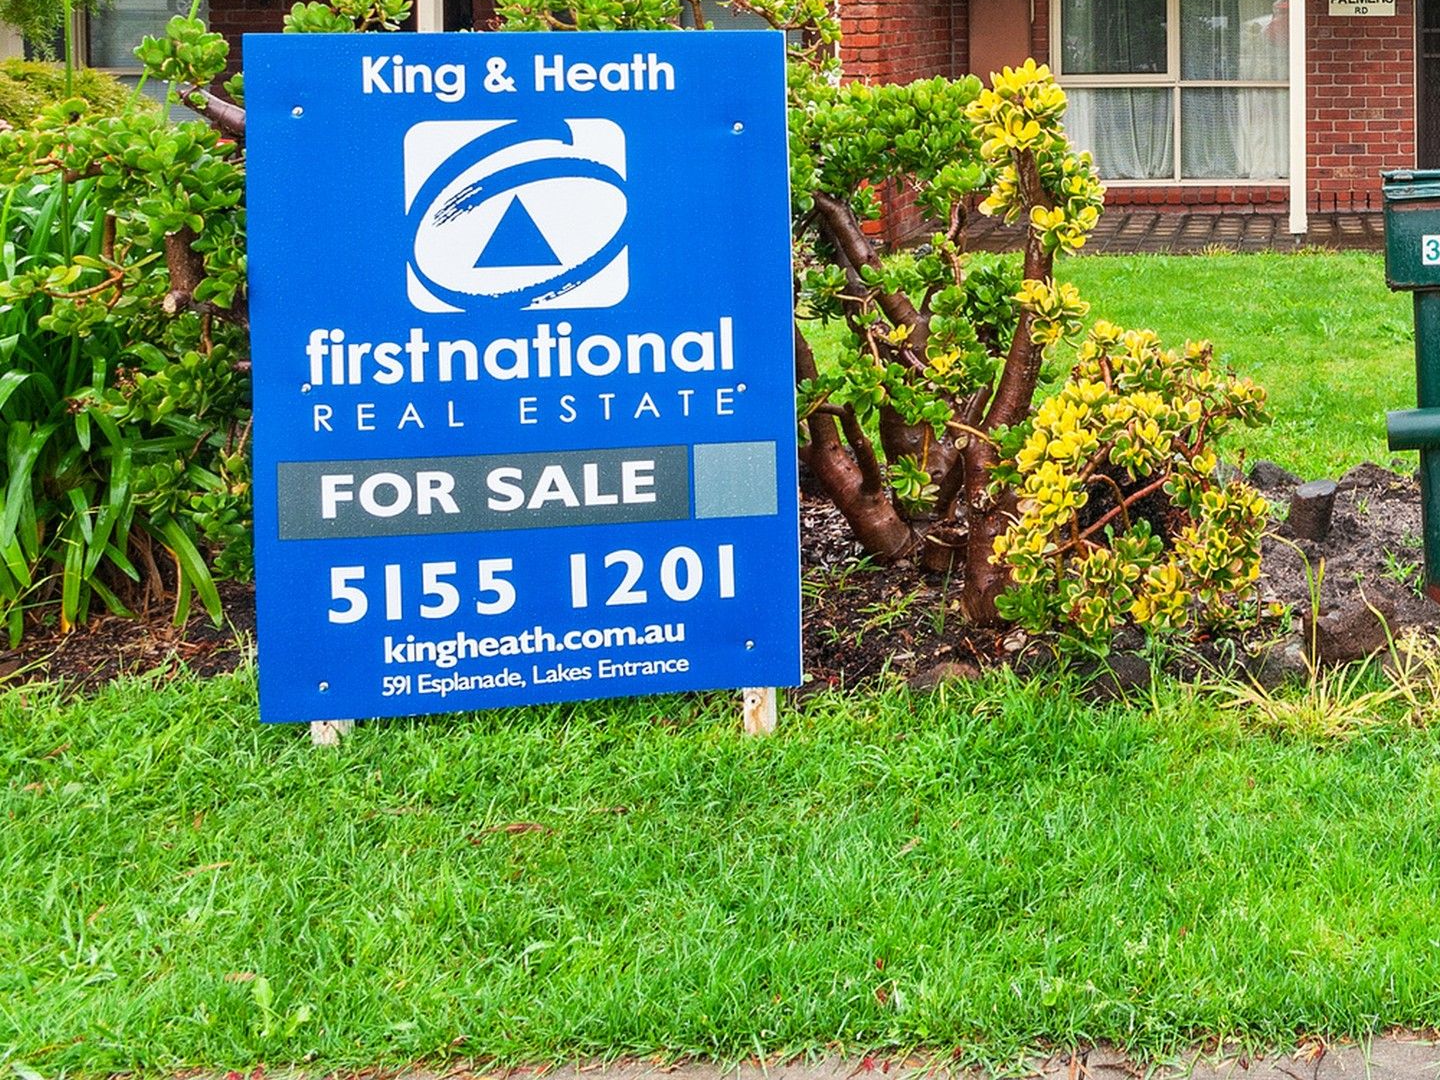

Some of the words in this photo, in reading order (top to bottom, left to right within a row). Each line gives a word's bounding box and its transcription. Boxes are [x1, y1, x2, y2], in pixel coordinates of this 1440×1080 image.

[1354, 6, 1369, 14] RD
[363, 55, 466, 102] King
[484, 57, 517, 92] &
[535, 54, 675, 91] Heath
[1426, 239, 1440, 261] 3
[314, 400, 464, 431] REAL
[519, 388, 735, 424] ESTATE
[321, 470, 460, 520] FOR
[487, 460, 657, 511] SALE
[328, 558, 516, 624] 5155
[570, 544, 735, 608] 1201
[384, 623, 686, 668] kingheath.com.au
[382, 675, 411, 696] 591
[418, 668, 526, 697] Esplanade,
[532, 664, 593, 685] Lakes
[598, 656, 690, 678] Entrance
